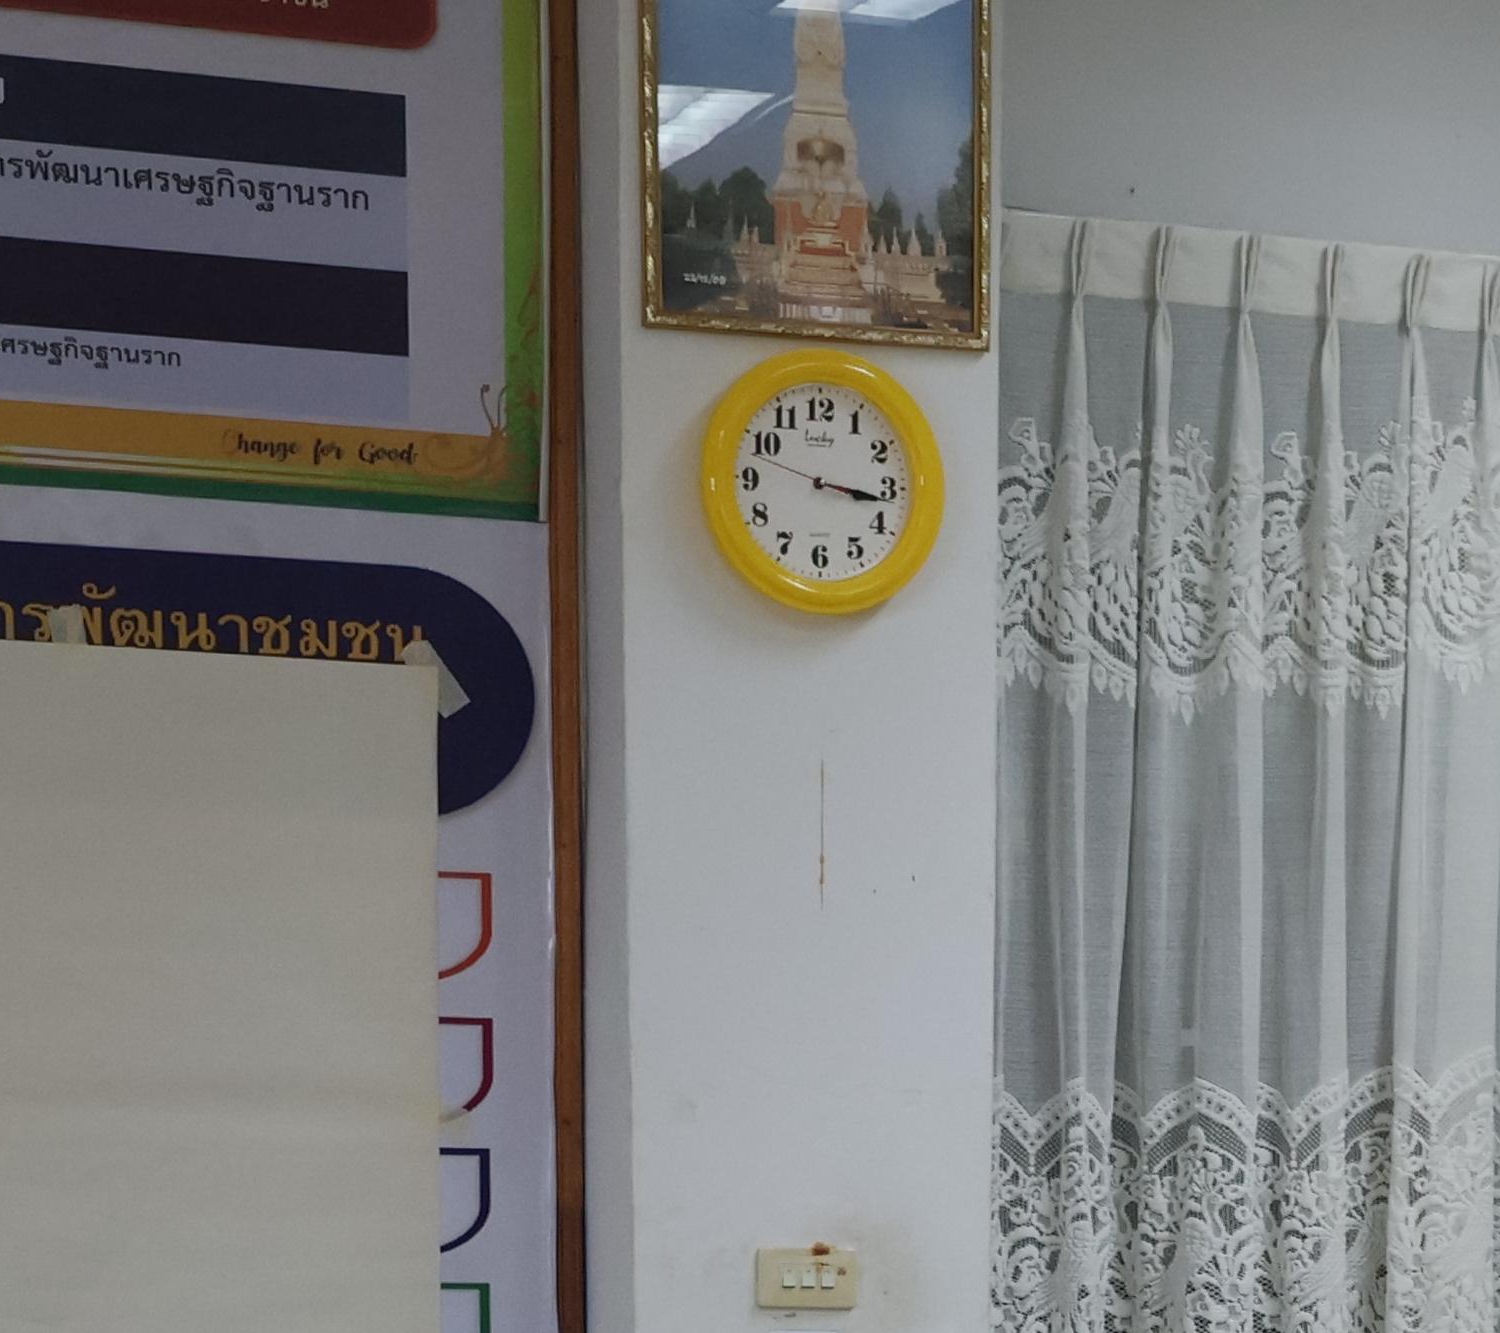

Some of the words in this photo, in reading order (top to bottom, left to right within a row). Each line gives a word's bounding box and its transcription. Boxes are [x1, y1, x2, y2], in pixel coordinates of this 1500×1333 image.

[773, 405, 798, 430] 11
[805, 396, 835, 423] 12
[849, 410, 862, 435] 1
[752, 430, 781, 456] 10
[870, 440, 888, 464] 2
[742, 466, 760, 491] 9
[880, 476, 897, 501] 3
[751, 502, 769, 527] 8
[869, 511, 888, 535] 4
[776, 531, 794, 555] 7
[846, 536, 864, 560] 5
[811, 545, 829, 569] 6
